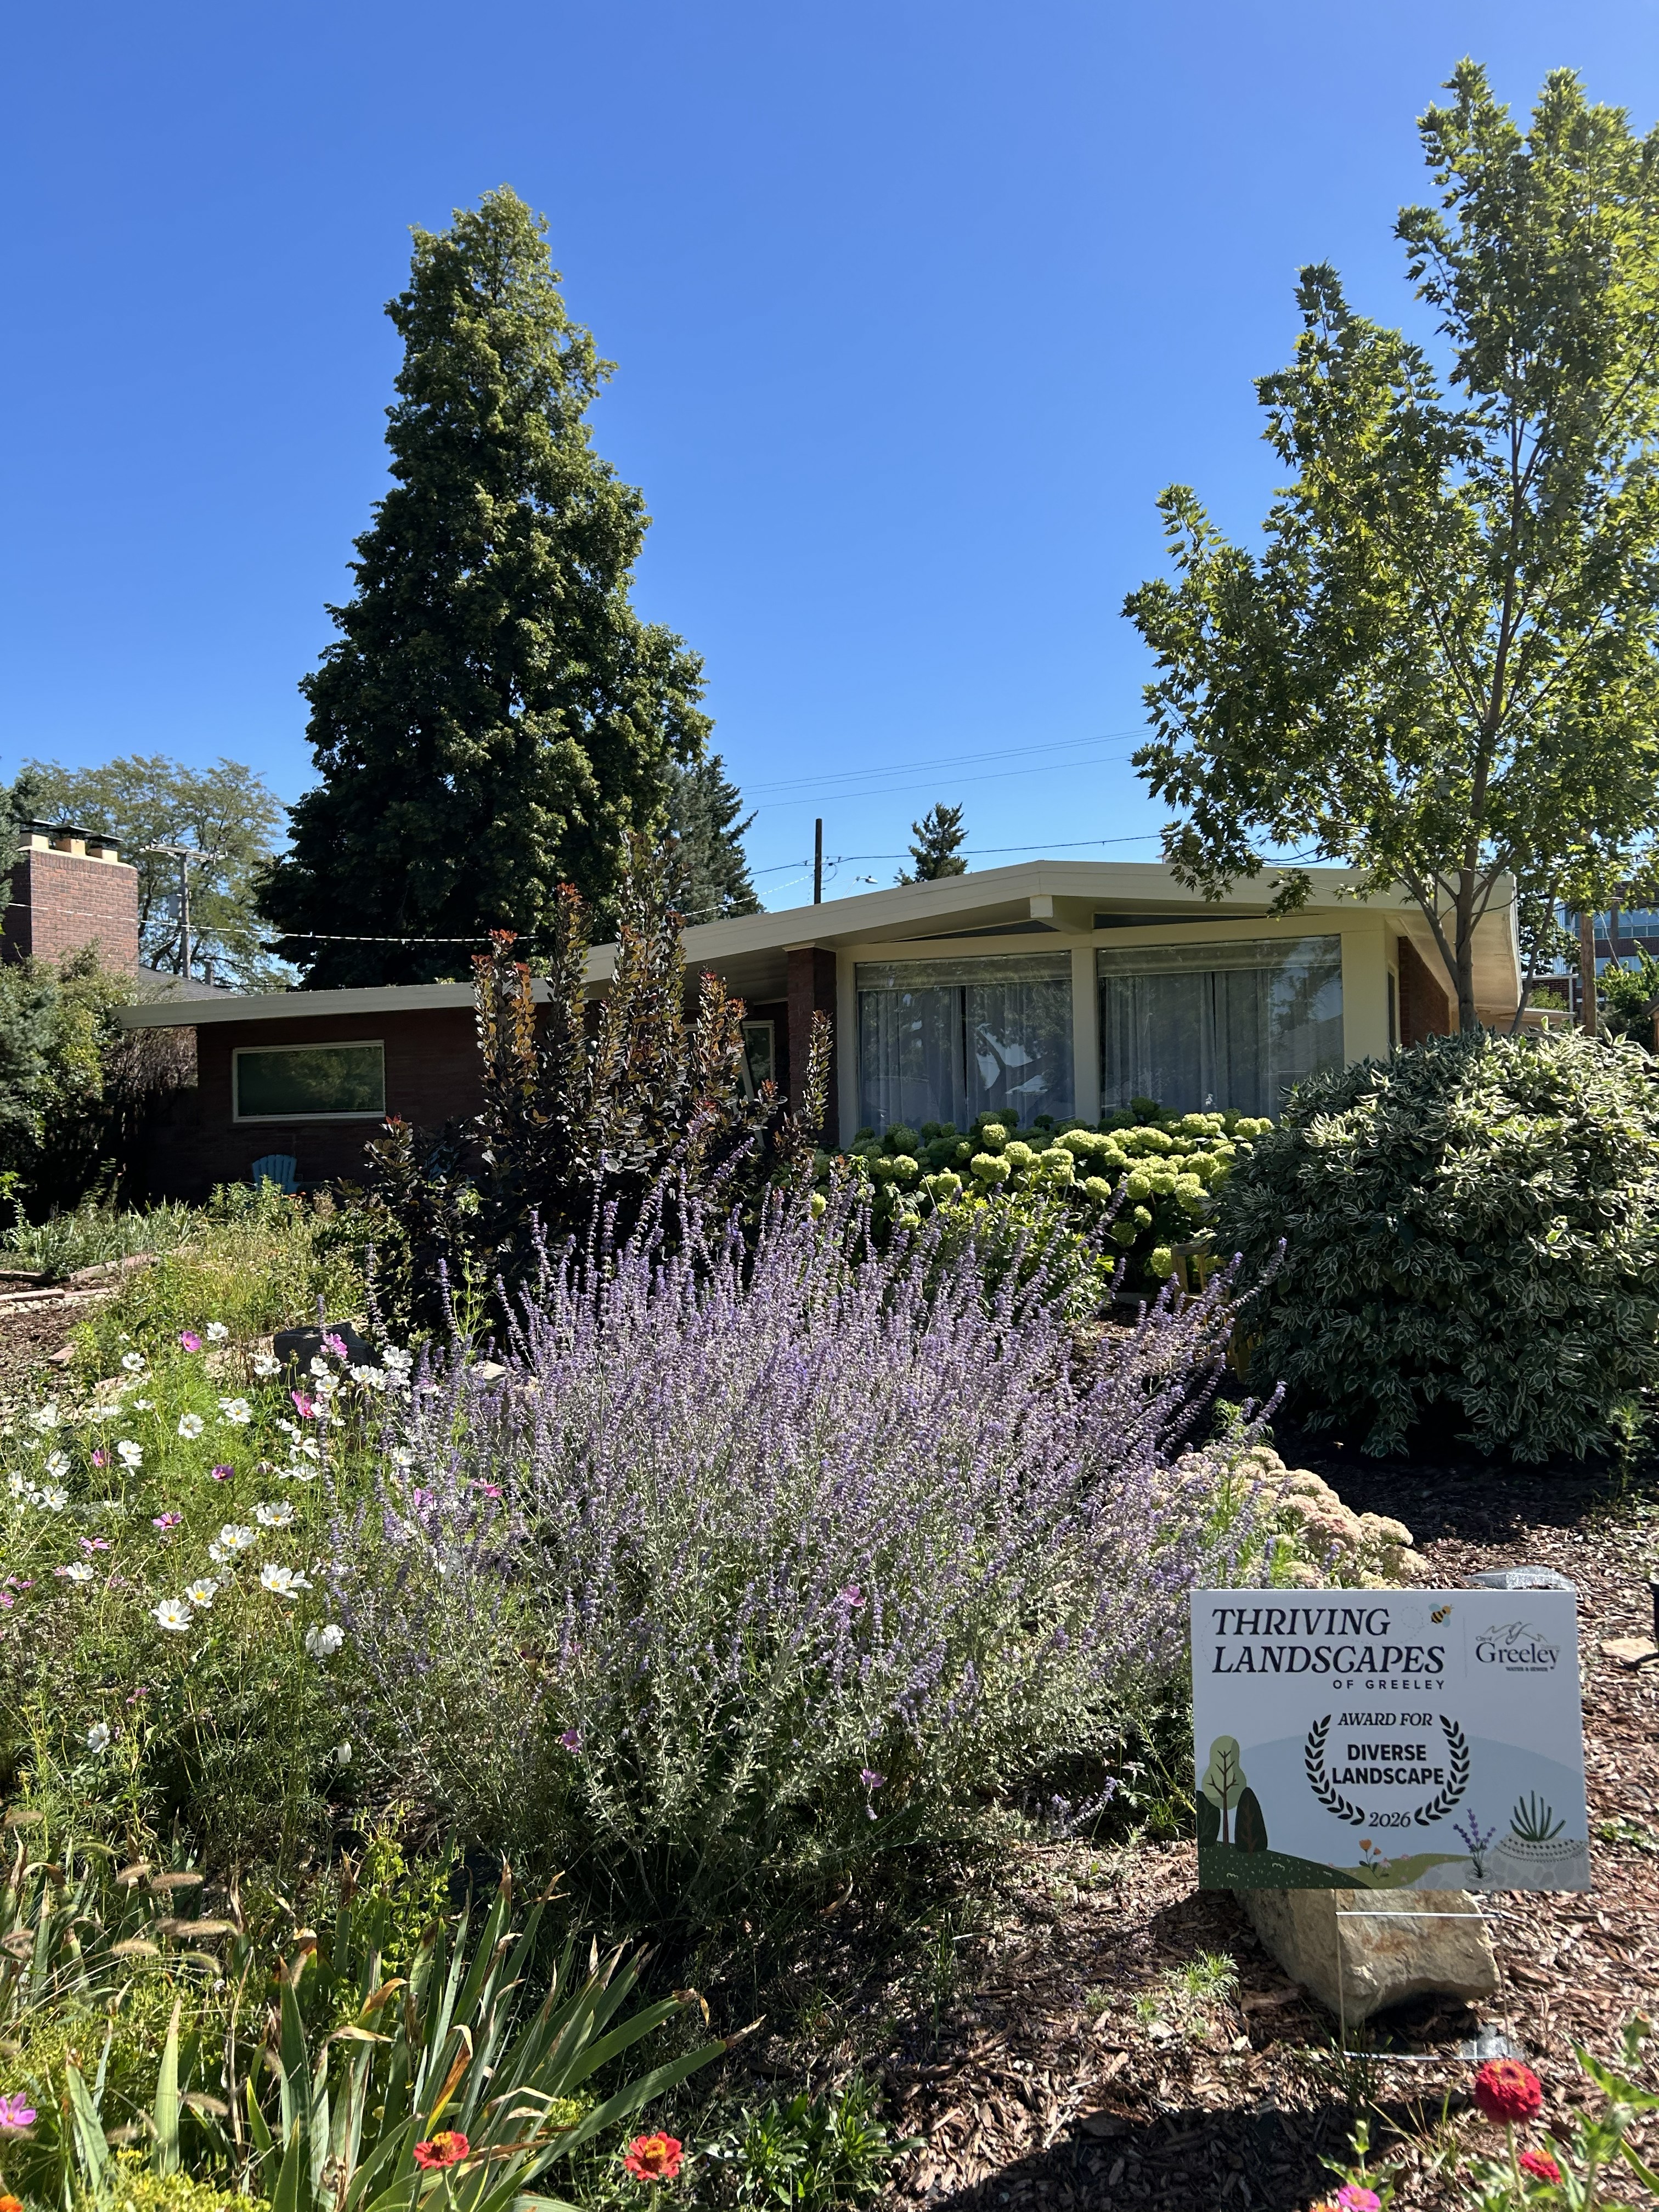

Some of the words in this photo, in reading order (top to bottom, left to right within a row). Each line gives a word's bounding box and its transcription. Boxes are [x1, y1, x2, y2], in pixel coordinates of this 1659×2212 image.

[1211, 1608, 1391, 1637] THRIVING
[1211, 1645, 1445, 1674] LANDSCAPES
[1475, 1642, 1560, 1670] Greeley
[1333, 1679, 1354, 1690] OF
[1365, 1679, 1444, 1690] GREELEY
[1337, 1712, 1397, 1726] AWARD
[1399, 1712, 1433, 1726] FOR
[1347, 1744, 1427, 1761] DIVERSE
[1331, 1767, 1444, 1785] LANDSCAPE
[1367, 1811, 1412, 1827] 2026
